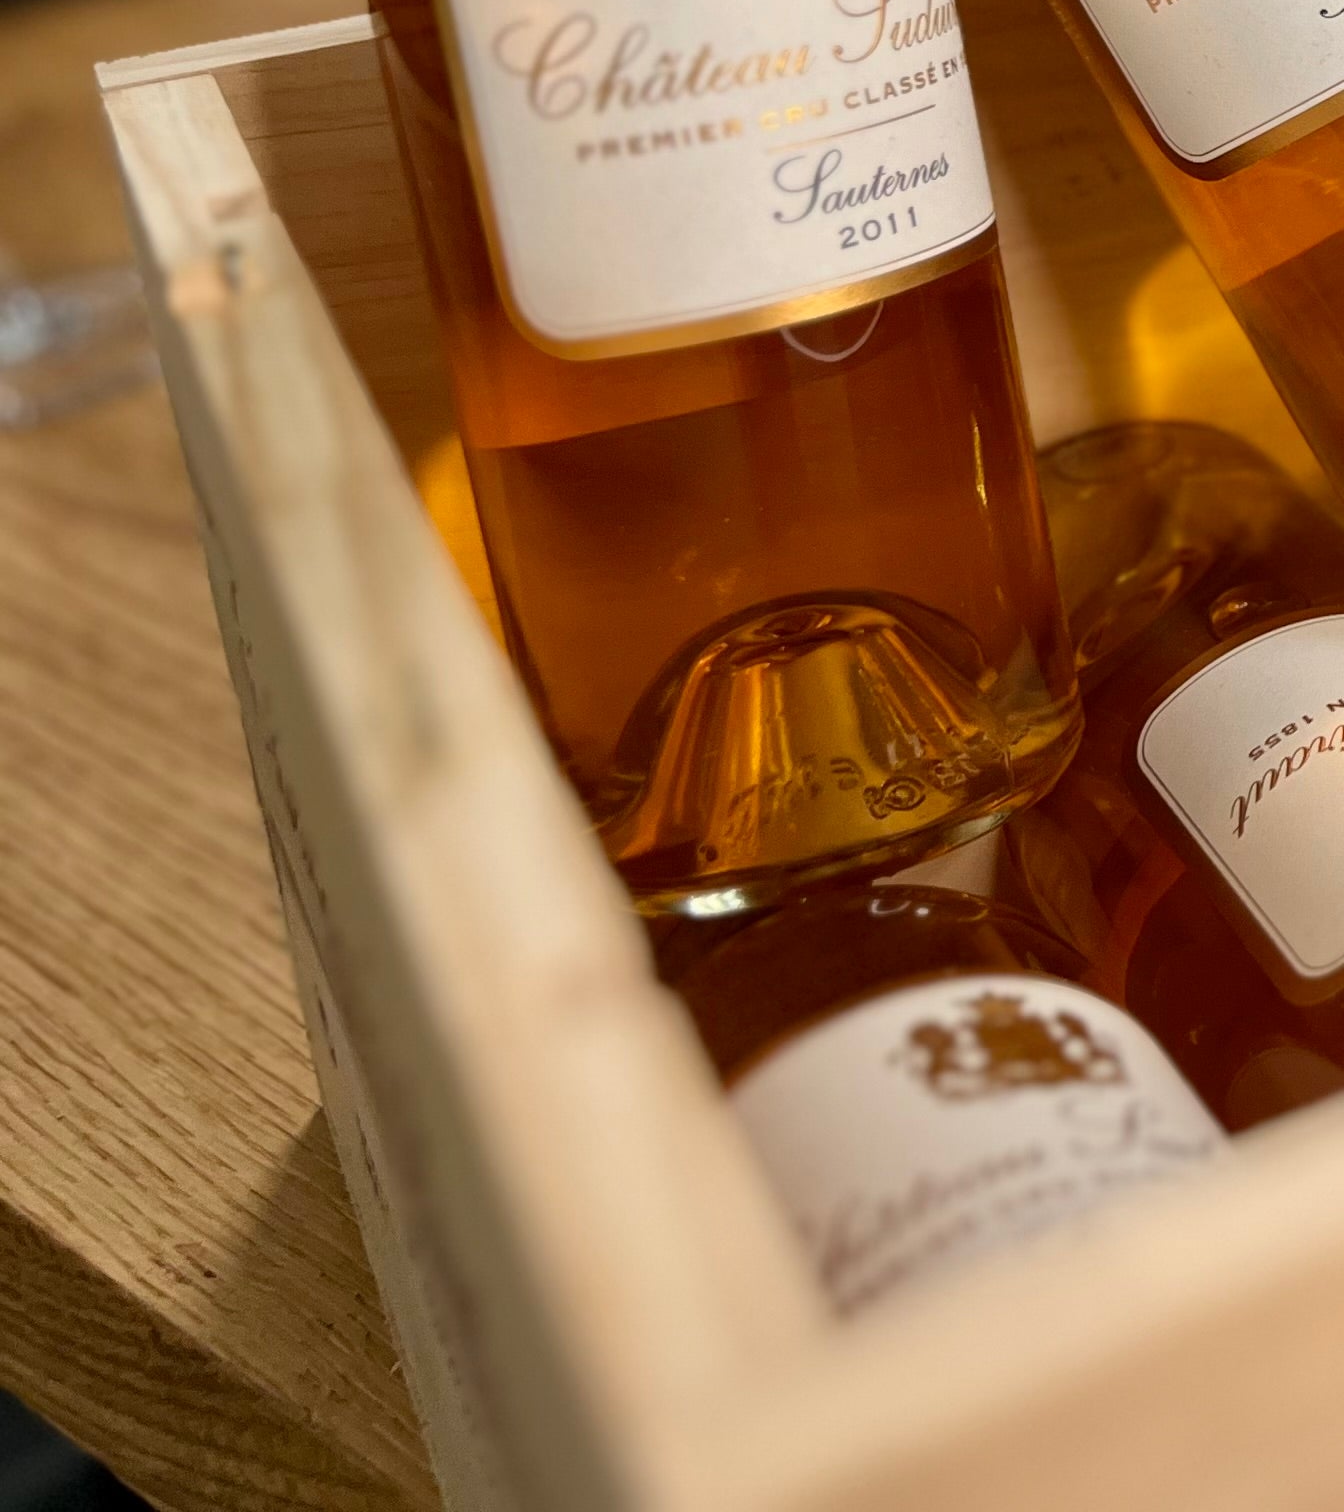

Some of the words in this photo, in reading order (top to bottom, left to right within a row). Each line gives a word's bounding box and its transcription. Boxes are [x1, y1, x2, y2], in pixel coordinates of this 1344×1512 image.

[492, 12, 815, 121] Château
[576, 118, 743, 164] PREMIER
[758, 98, 829, 133] CRU
[843, 61, 938, 110] CLASSÉ
[772, 148, 951, 224] Sauternes
[838, 205, 920, 250] 2011
[1248, 715, 1314, 763] 1855
